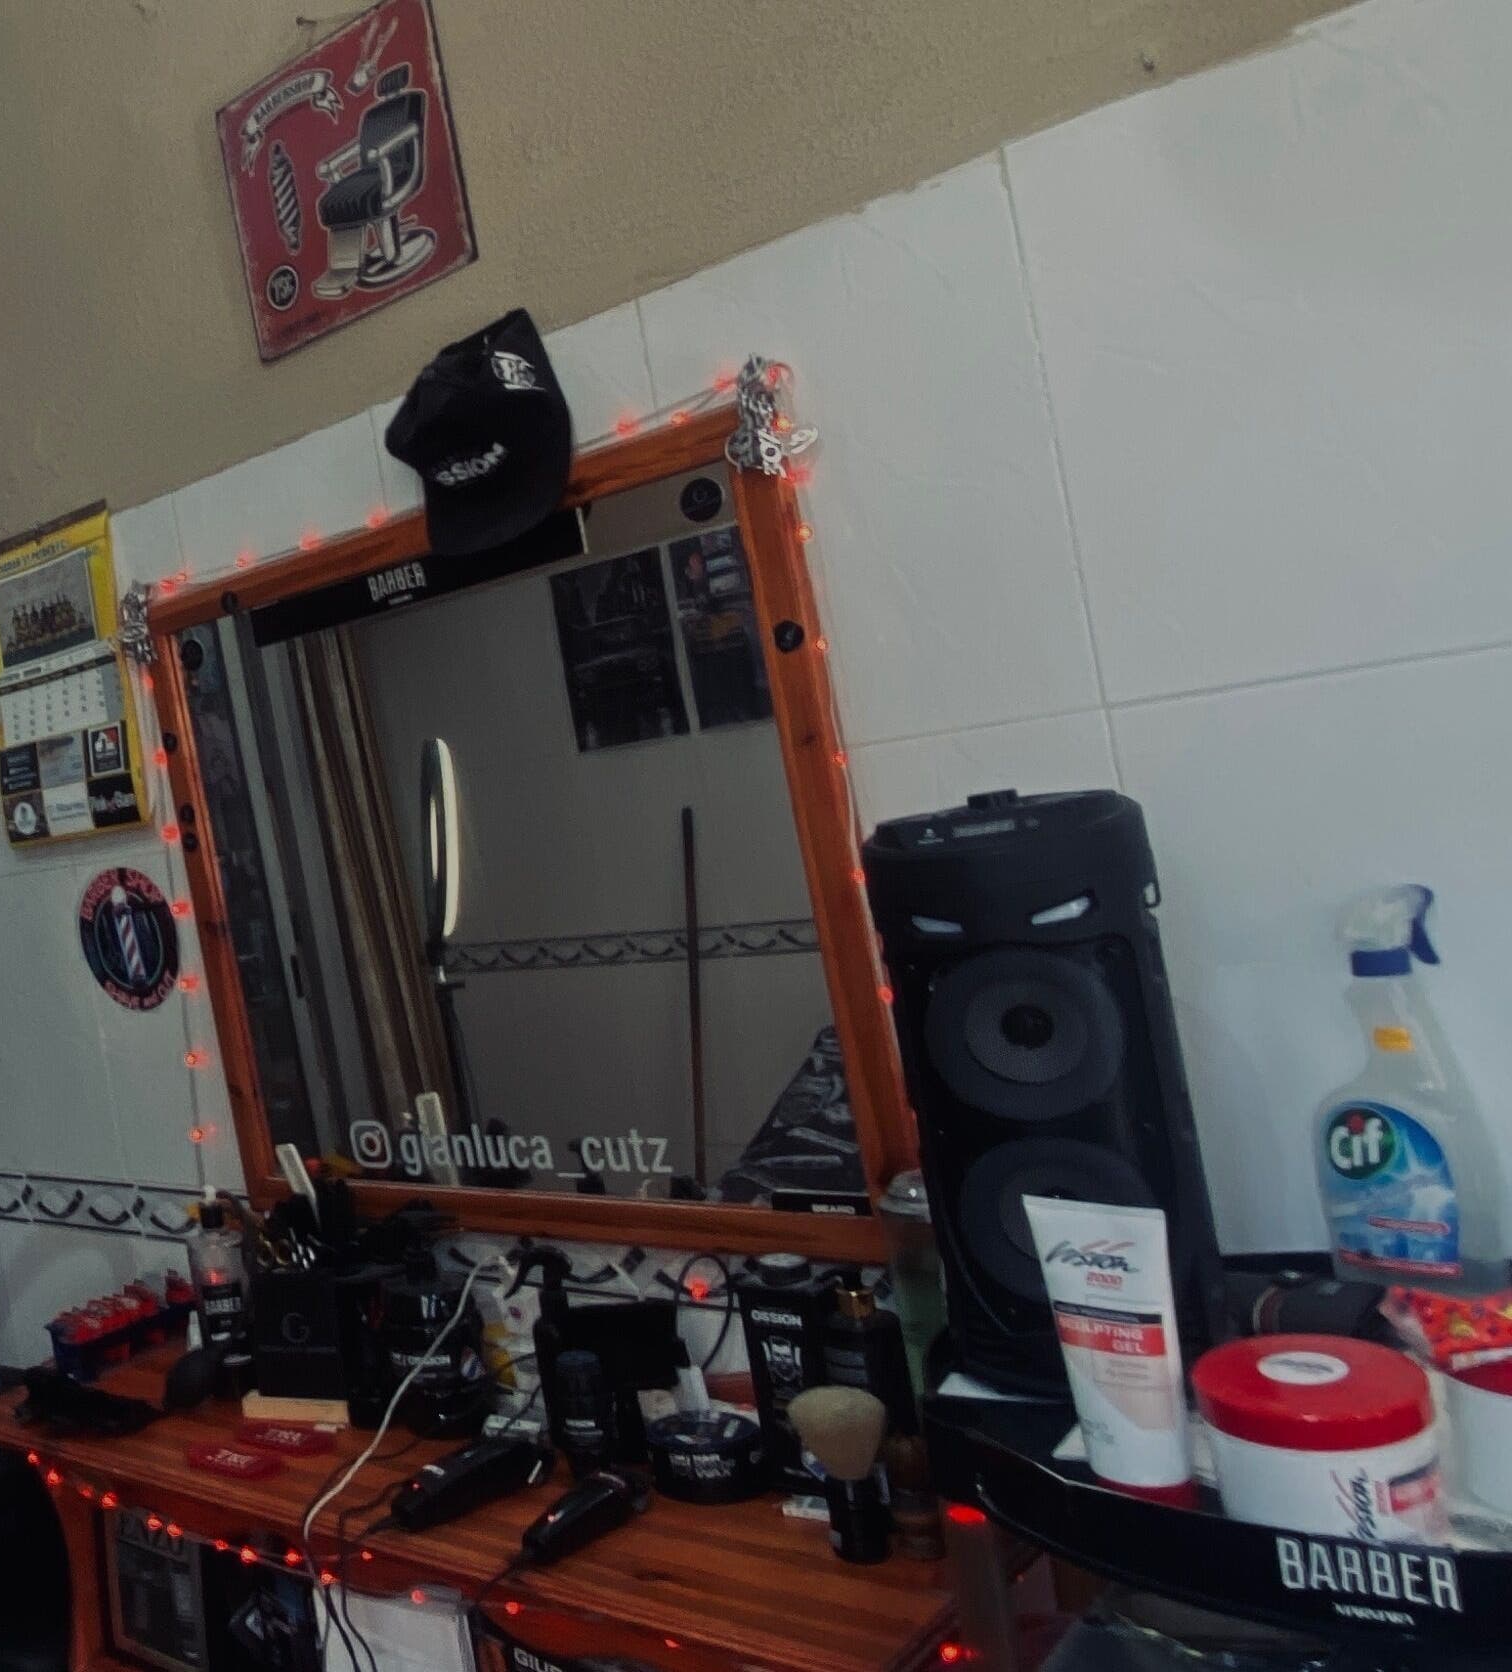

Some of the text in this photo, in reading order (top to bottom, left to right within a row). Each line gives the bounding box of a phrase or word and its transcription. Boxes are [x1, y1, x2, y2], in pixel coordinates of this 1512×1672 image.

[367, 561, 426, 603] BARBER
[399, 1123, 674, 1177] gianluca_cutz
[750, 1308, 804, 1328] OSSION
[1275, 1535, 1464, 1614] BARBER
